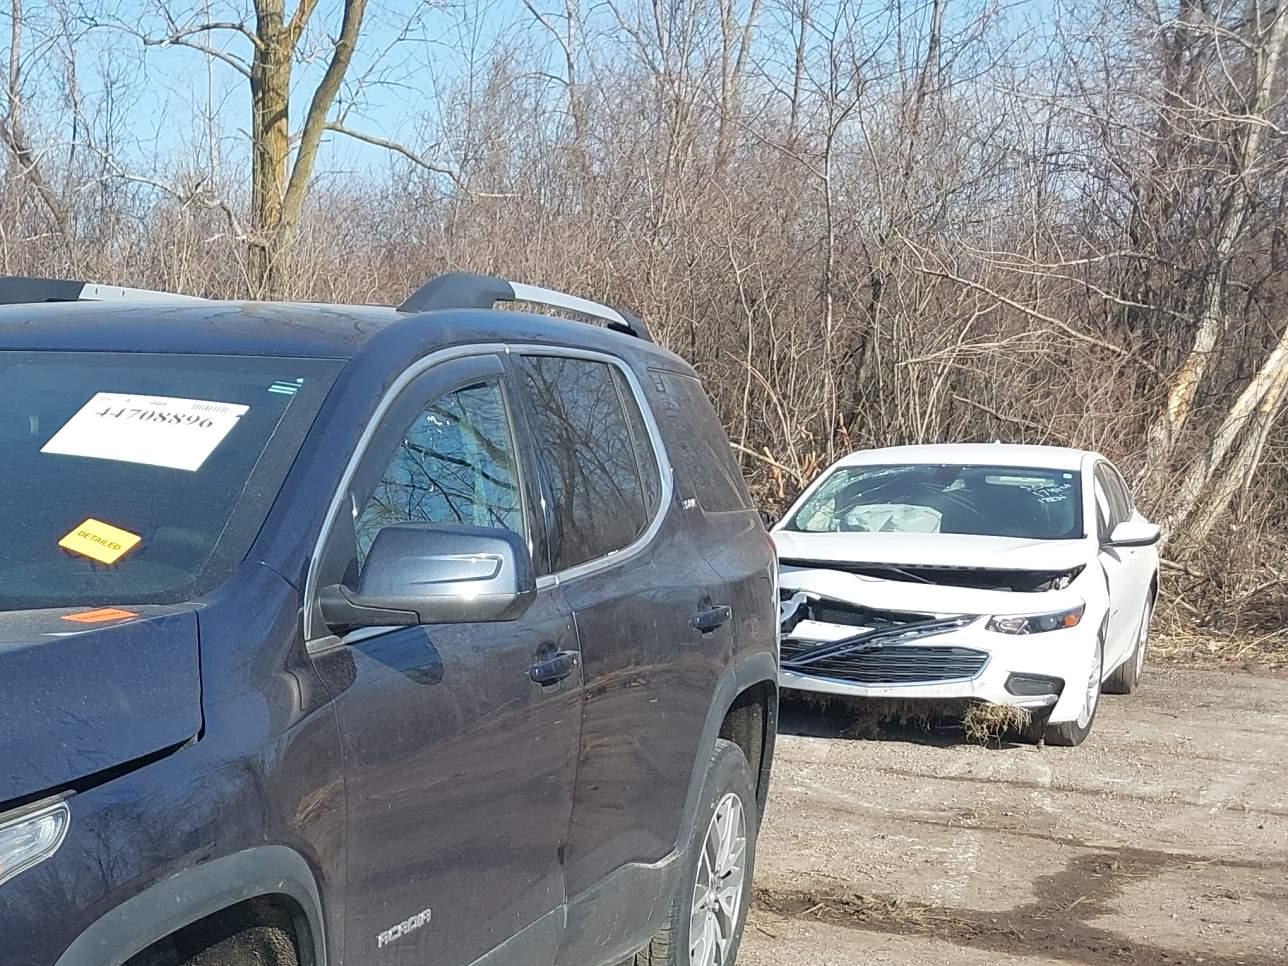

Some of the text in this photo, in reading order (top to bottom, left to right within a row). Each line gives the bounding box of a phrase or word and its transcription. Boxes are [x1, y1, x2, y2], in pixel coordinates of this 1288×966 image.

[96, 407, 214, 428] 44708896
[77, 530, 122, 551] DETAILED
[376, 908, 432, 948] ACADIA
